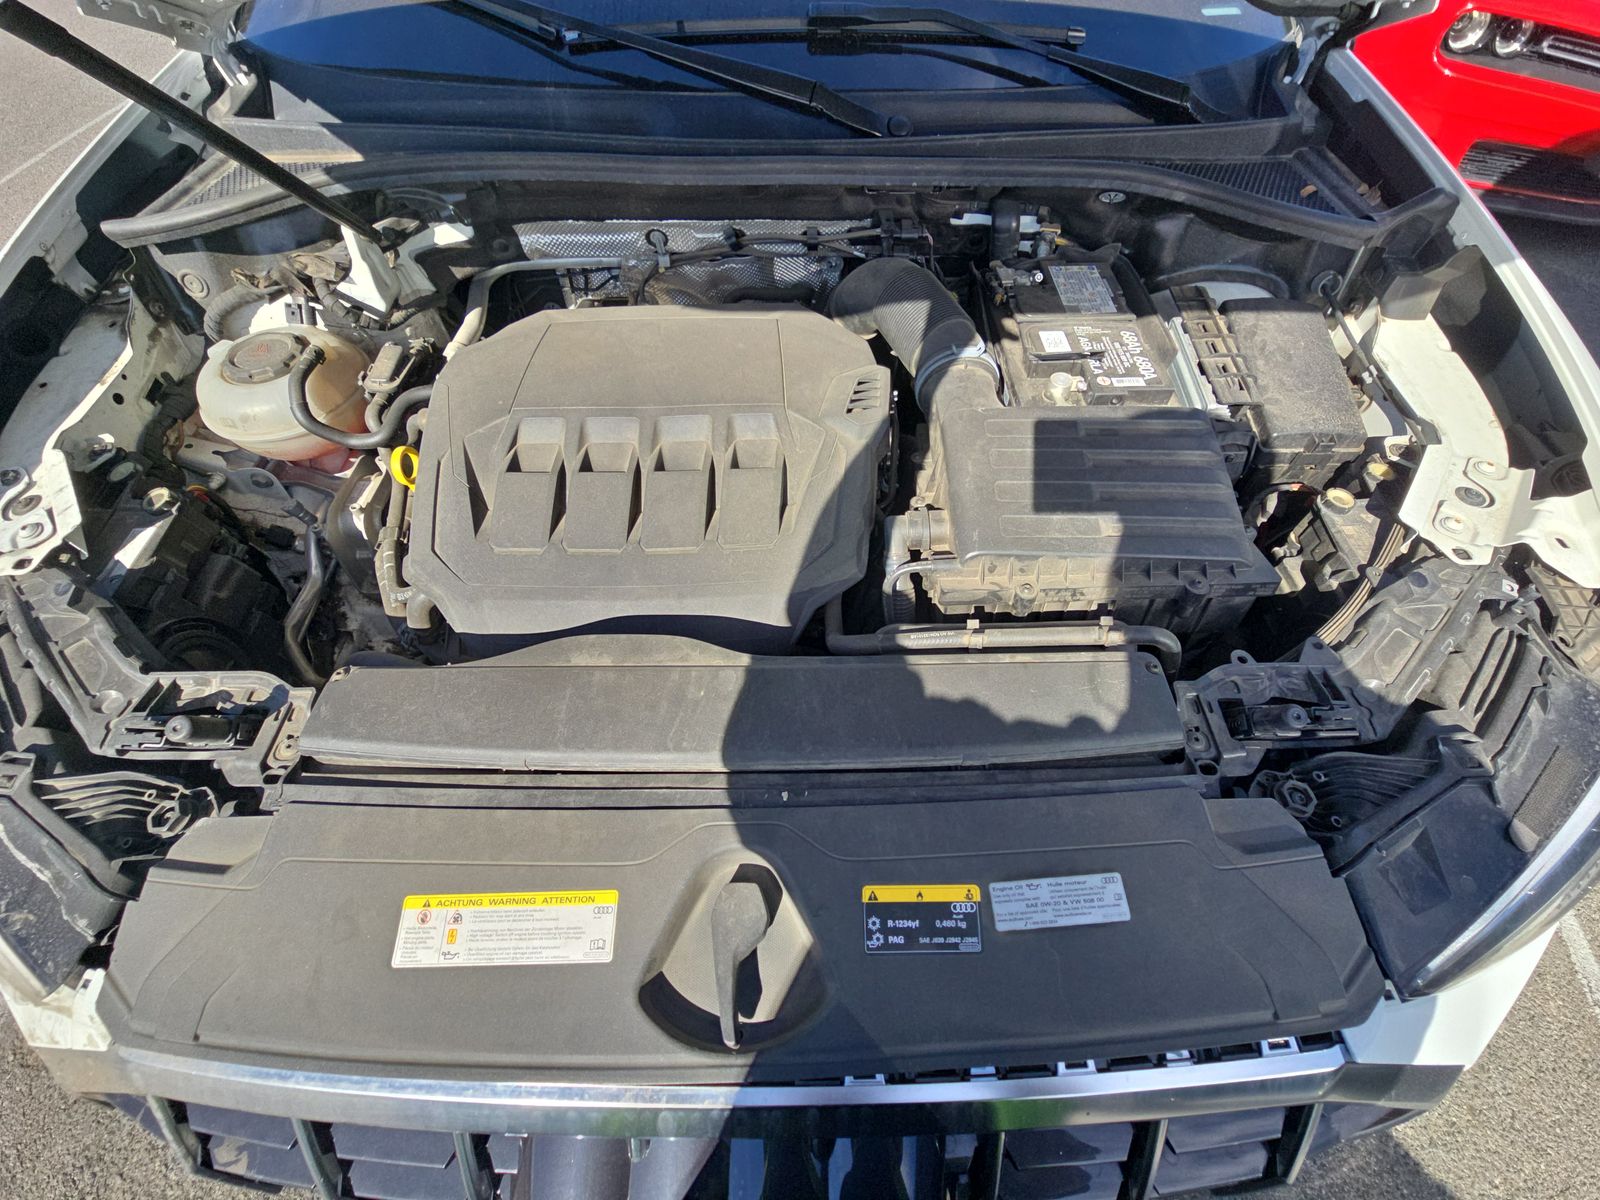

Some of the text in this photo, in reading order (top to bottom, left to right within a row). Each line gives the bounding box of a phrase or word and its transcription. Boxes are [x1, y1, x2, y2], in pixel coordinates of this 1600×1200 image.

[1120, 330, 1143, 354] 68Ah
[1134, 356, 1158, 380] 680A
[436, 896, 596, 908] ACHTUNG WARNING ATTENTION
[887, 919, 920, 929] R-1234yf
[958, 920, 967, 928] kg
[888, 936, 904, 944] PAG
